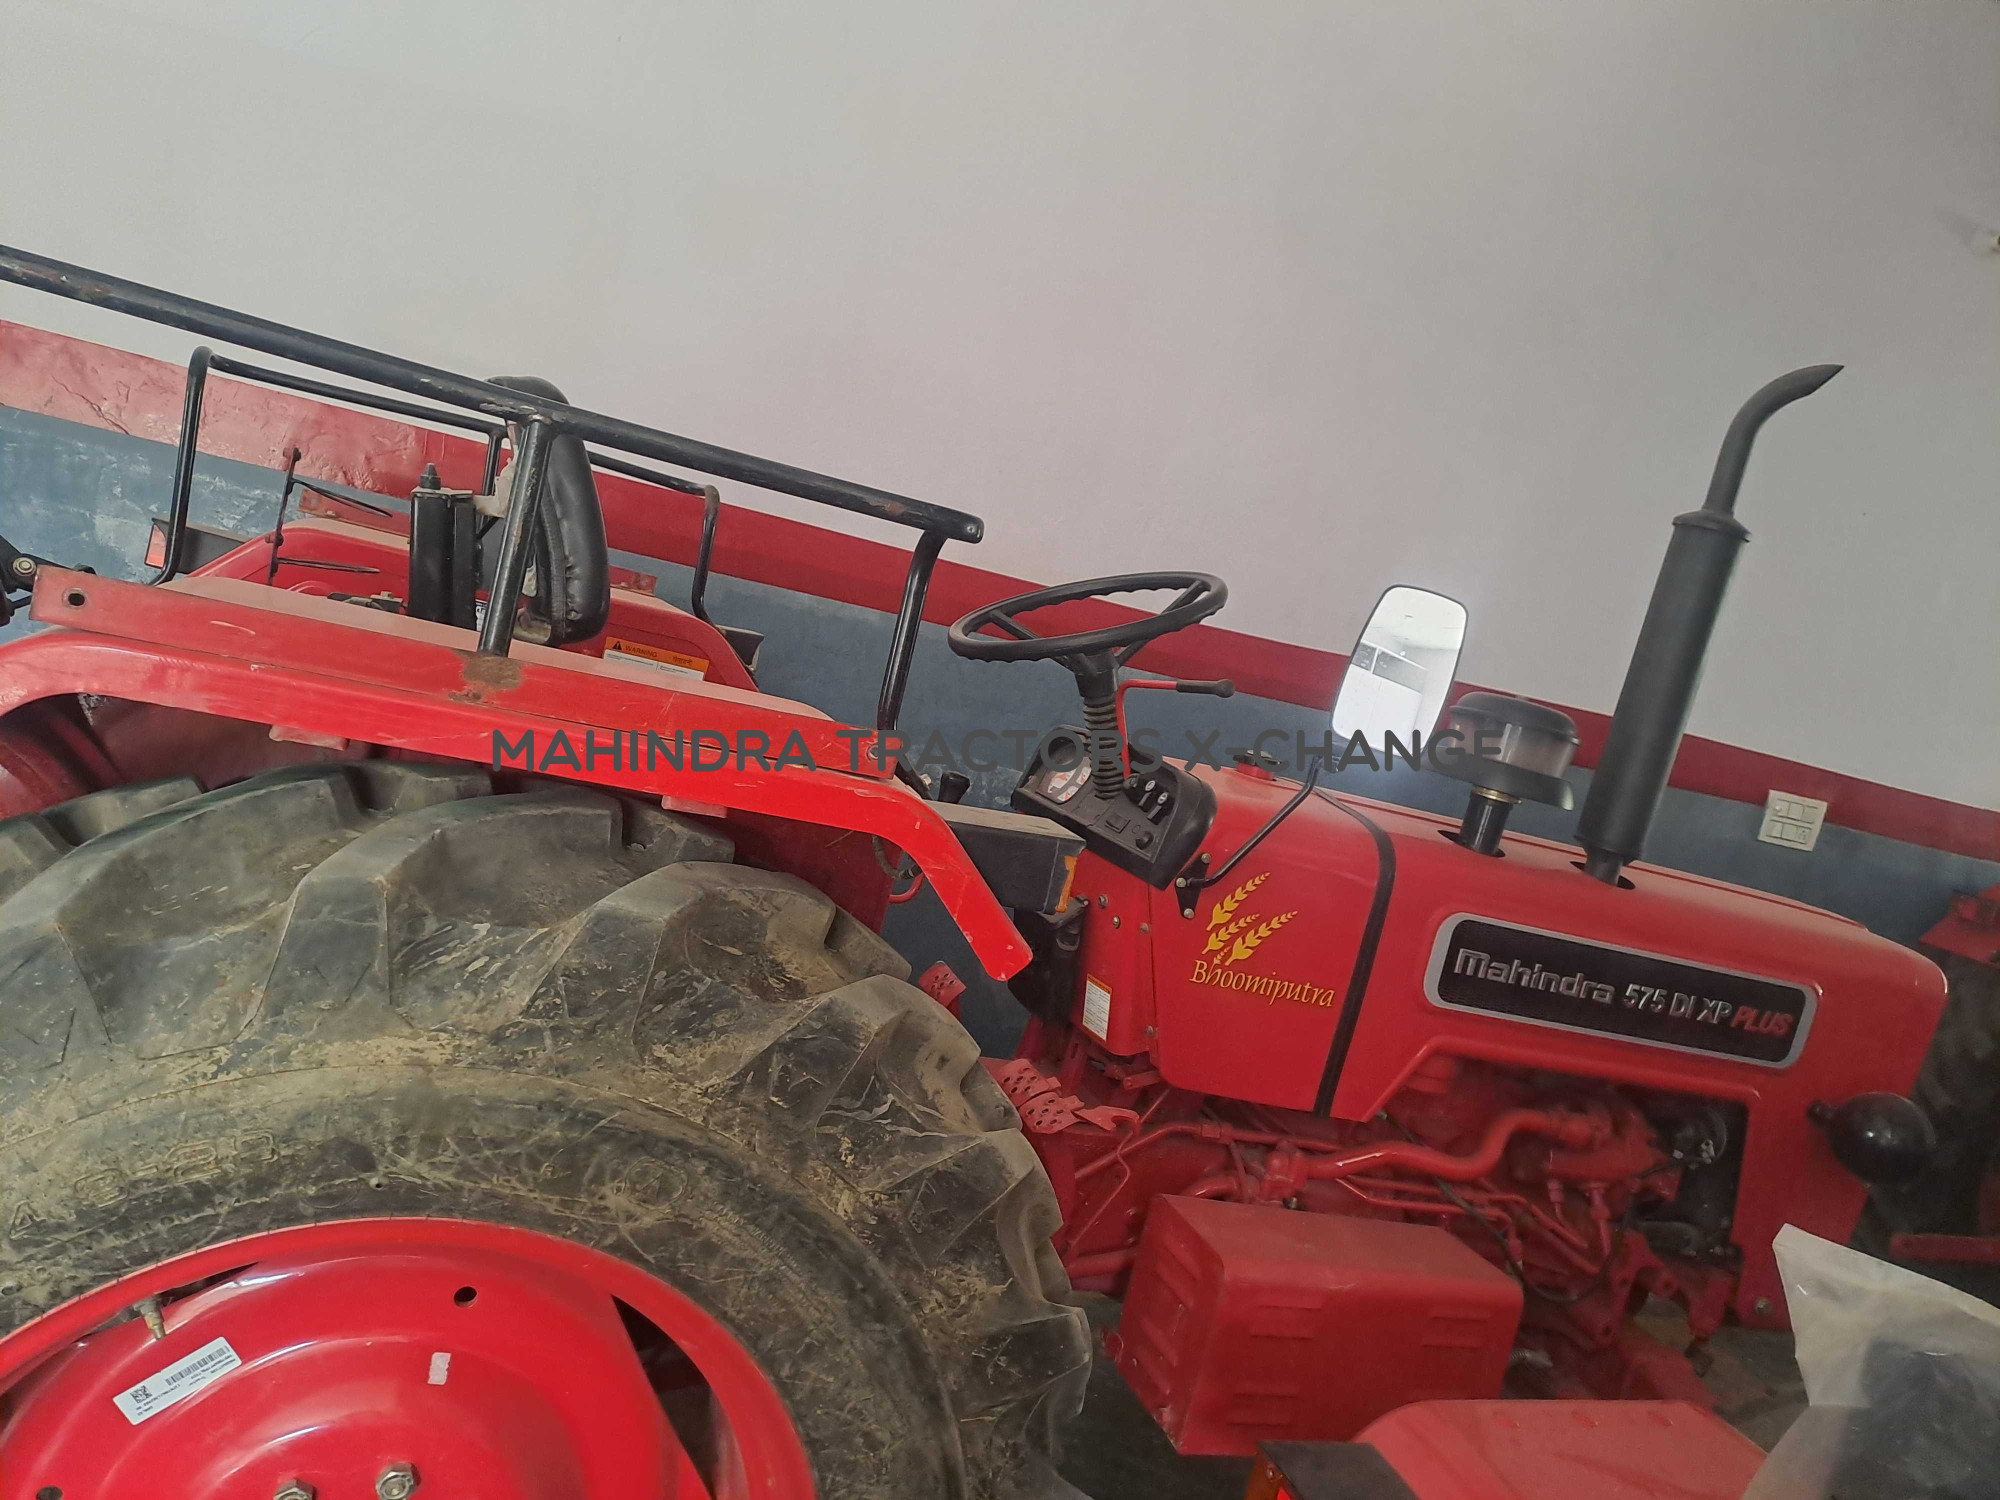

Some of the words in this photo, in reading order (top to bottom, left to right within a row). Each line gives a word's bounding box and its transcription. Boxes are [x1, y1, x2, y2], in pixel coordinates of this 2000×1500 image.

[1189, 959, 1336, 1007] Bhoomiputra
[1454, 948, 1615, 1004] Mahindra
[1624, 984, 1667, 1013] 575
[1669, 992, 1697, 1019] DI
[1697, 998, 1732, 1024] XP
[1731, 1005, 1793, 1034] PLUS
